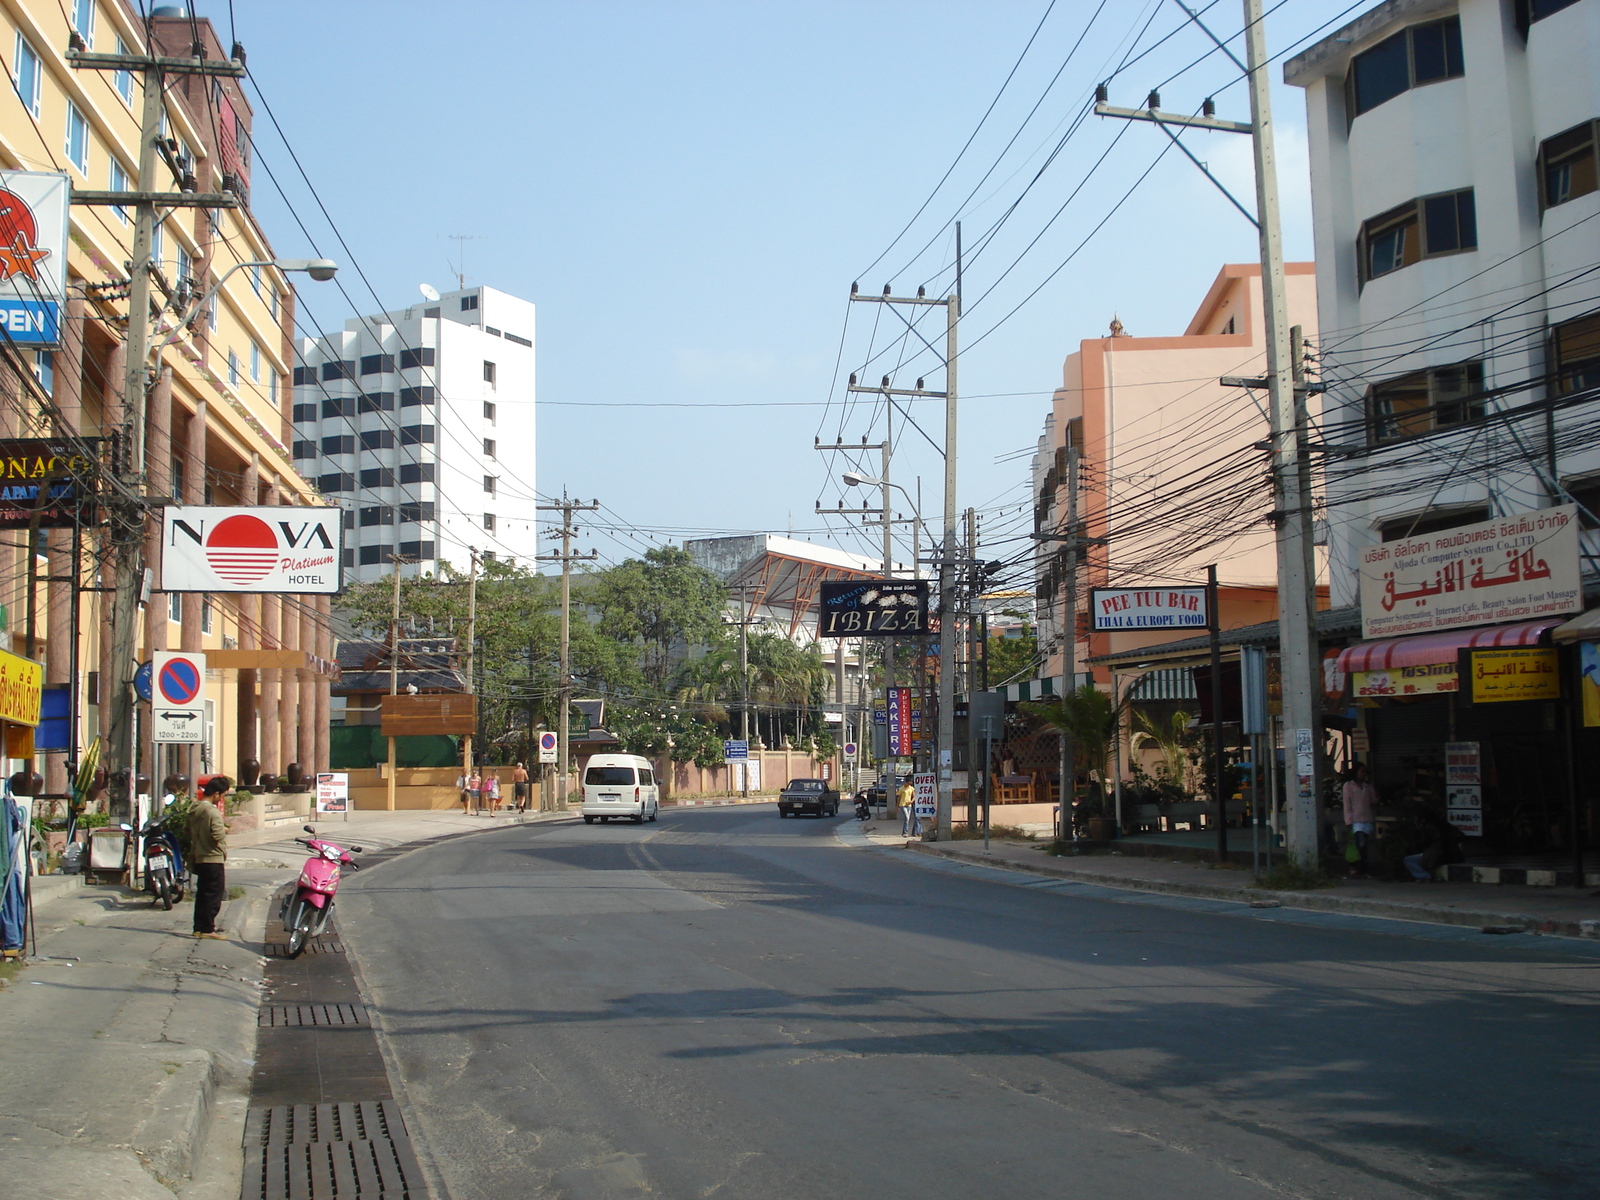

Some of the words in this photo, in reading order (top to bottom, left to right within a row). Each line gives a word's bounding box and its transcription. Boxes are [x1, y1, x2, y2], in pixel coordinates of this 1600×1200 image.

[0, 309, 45, 332] PEN
[1537, 512, 1569, 530] จำกัด
[281, 555, 335, 574] Platinum
[1393, 557, 1419, 571] Aljoda
[1421, 550, 1462, 565] Computer
[1464, 543, 1494, 558] System
[289, 575, 326, 585] HOTEL
[827, 586, 867, 606] Return
[847, 598, 859, 610] of
[1101, 593, 1131, 615] PEE
[1134, 591, 1163, 607] TUU
[1168, 592, 1199, 611] BAR
[1436, 603, 1462, 616] Internet
[1483, 598, 1505, 611] Beauty
[1508, 595, 1527, 607] Salon
[1529, 592, 1545, 603] Foot
[1547, 588, 1578, 600] Massage
[827, 609, 922, 633] IBIZA
[1097, 616, 1123, 628] THAI
[1126, 615, 1134, 627] &
[1137, 614, 1175, 627] EUROPE
[1179, 613, 1205, 625] FOOD
[889, 690, 900, 755] BAKERY
[915, 775, 935, 785] OVER
[919, 786, 933, 795] SEA
[917, 796, 935, 805] CALL
